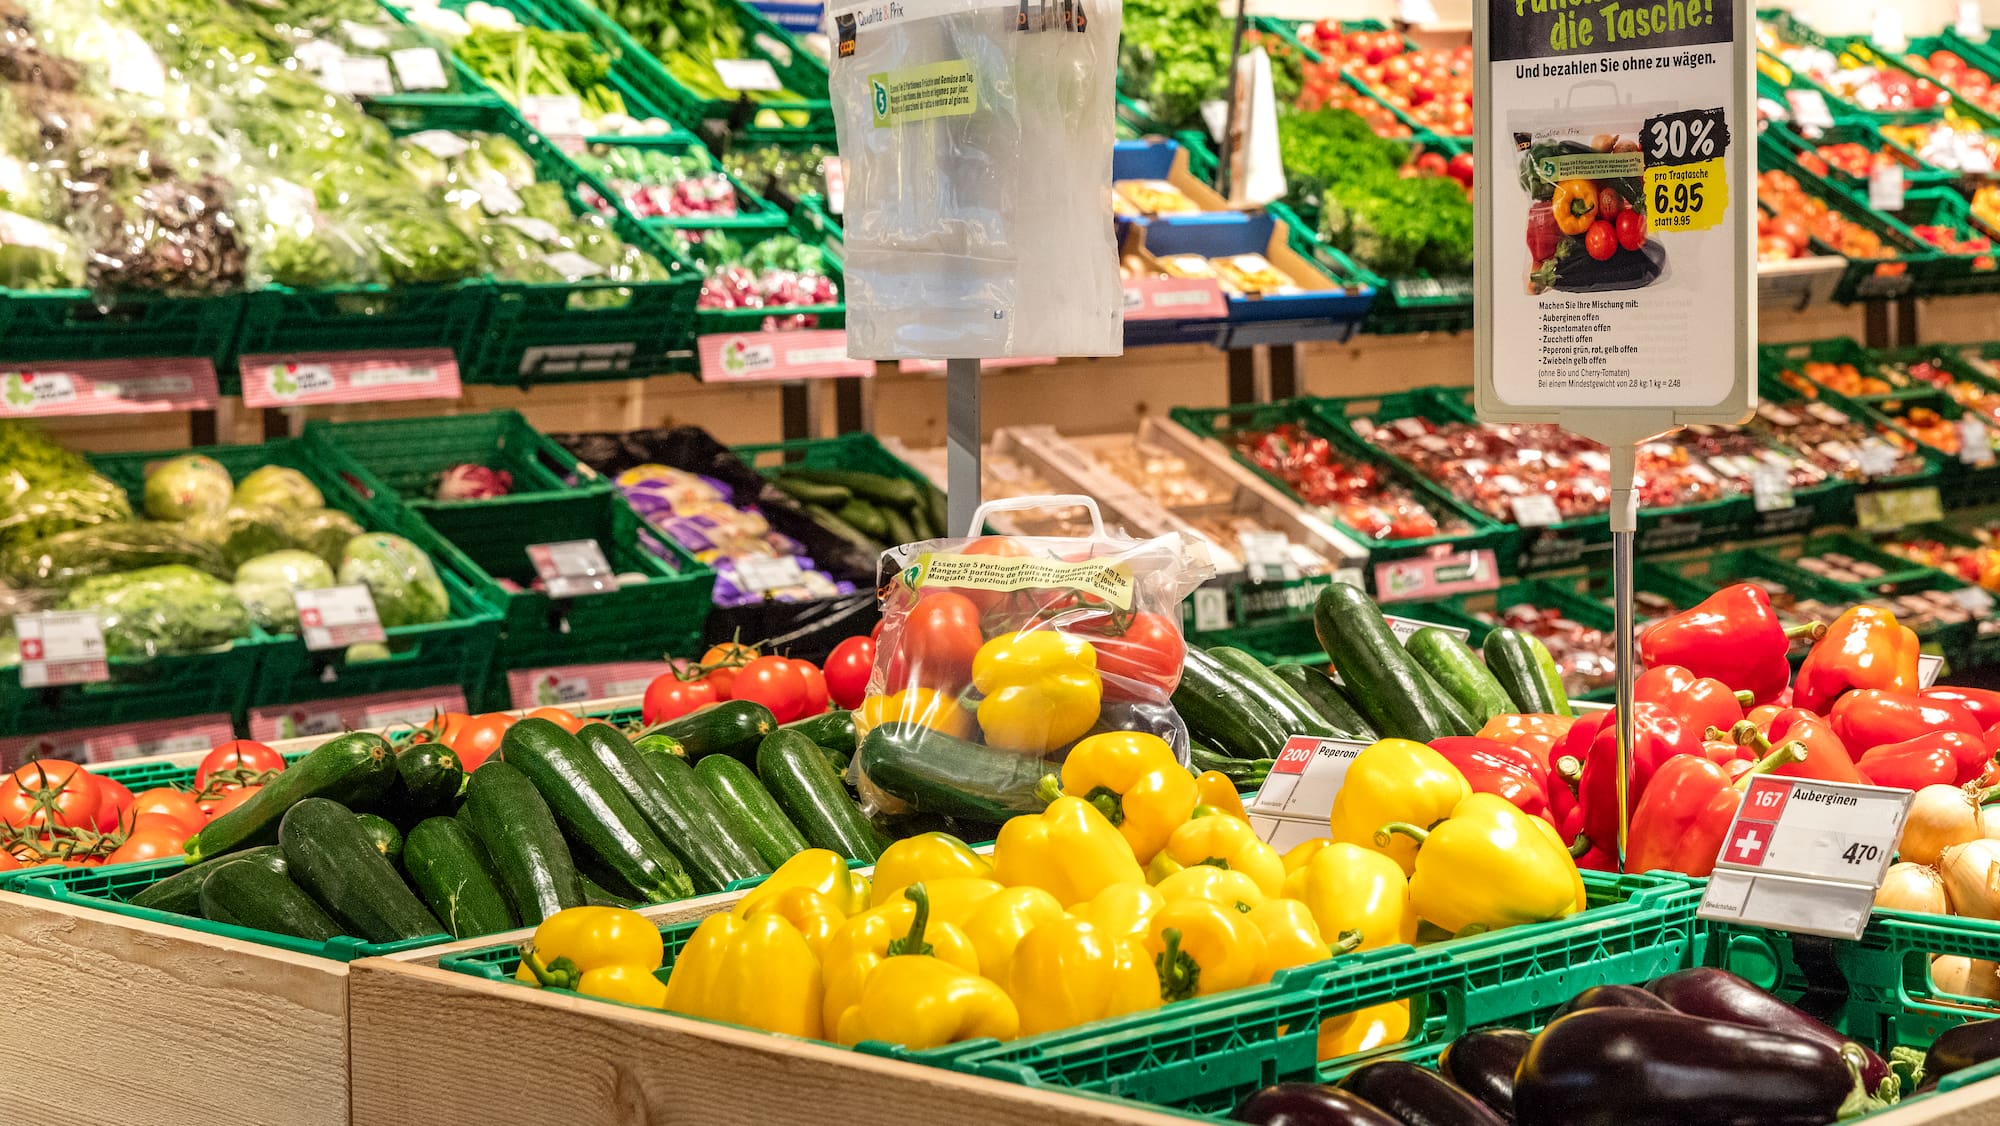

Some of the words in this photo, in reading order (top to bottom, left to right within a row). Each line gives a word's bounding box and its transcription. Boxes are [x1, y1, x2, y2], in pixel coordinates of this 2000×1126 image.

[1550, 10, 1594, 51] die
[1599, 0, 1713, 42] Tasche!
[1516, 64, 1540, 79] Und
[1543, 60, 1597, 77] bezahlen
[1600, 58, 1619, 73] Sie
[1622, 57, 1652, 71] ohne
[1655, 56, 1671, 69] zu
[1673, 52, 1716, 69] wägen.
[1650, 119, 1715, 159] 30%
[1654, 172, 1667, 182] pro
[1669, 169, 1709, 182] Tragtasche
[1655, 182, 1704, 214] 6.95
[1654, 217, 1673, 227] statt
[1673, 215, 1691, 226] 9.95
[1539, 301, 1565, 310] Machen
[1565, 301, 1576, 309] Sie
[1577, 300, 1591, 309] Ihre
[1592, 300, 1624, 309] Mischung
[1625, 299, 1639, 308] mit:
[1543, 313, 1581, 323] Auberginen
[1581, 312, 1600, 321] offen
[1543, 324, 1593, 334] Rispentomaten
[1593, 323, 1612, 332] offen
[1543, 334, 1575, 343] Zucchetti
[1575, 334, 1593, 343] offen
[1543, 346, 1572, 355] Peperoni
[1573, 345, 1590, 355] grün,
[1604, 345, 1619, 355] gelb
[1619, 345, 1638, 353] offen
[1543, 356, 1572, 365] Zwiebeln
[1573, 356, 1588, 366] gelb
[1588, 356, 1607, 364] offen
[1538, 368, 1555, 377] (ohne
[1556, 368, 1567, 377] Bio
[1568, 368, 1580, 377] und
[1580, 368, 1631, 378] Cherry-Tomaten)
[1538, 380, 1548, 388] Bei
[1548, 380, 1567, 388] einem
[1568, 379, 1615, 389] Mindestgewicht
[1616, 380, 1628, 388] von
[1654, 379, 1662, 389] kg
[930, 567, 961, 575] Mangez
[969, 568, 1004, 578] portions
[932, 560, 957, 568] Essen
[979, 562, 1020, 572] Portionen
[1104, 566, 1115, 577] am
[927, 573, 965, 582] Mangiate
[974, 575, 1008, 585] porzioni
[1018, 576, 1042, 584] frutta
[1282, 748, 1310, 762] 200
[1318, 745, 1360, 759] Peperoni
[1755, 790, 1783, 808] 167
[1792, 788, 1858, 807] Auberginen
[1842, 842, 1878, 866] 4.70
